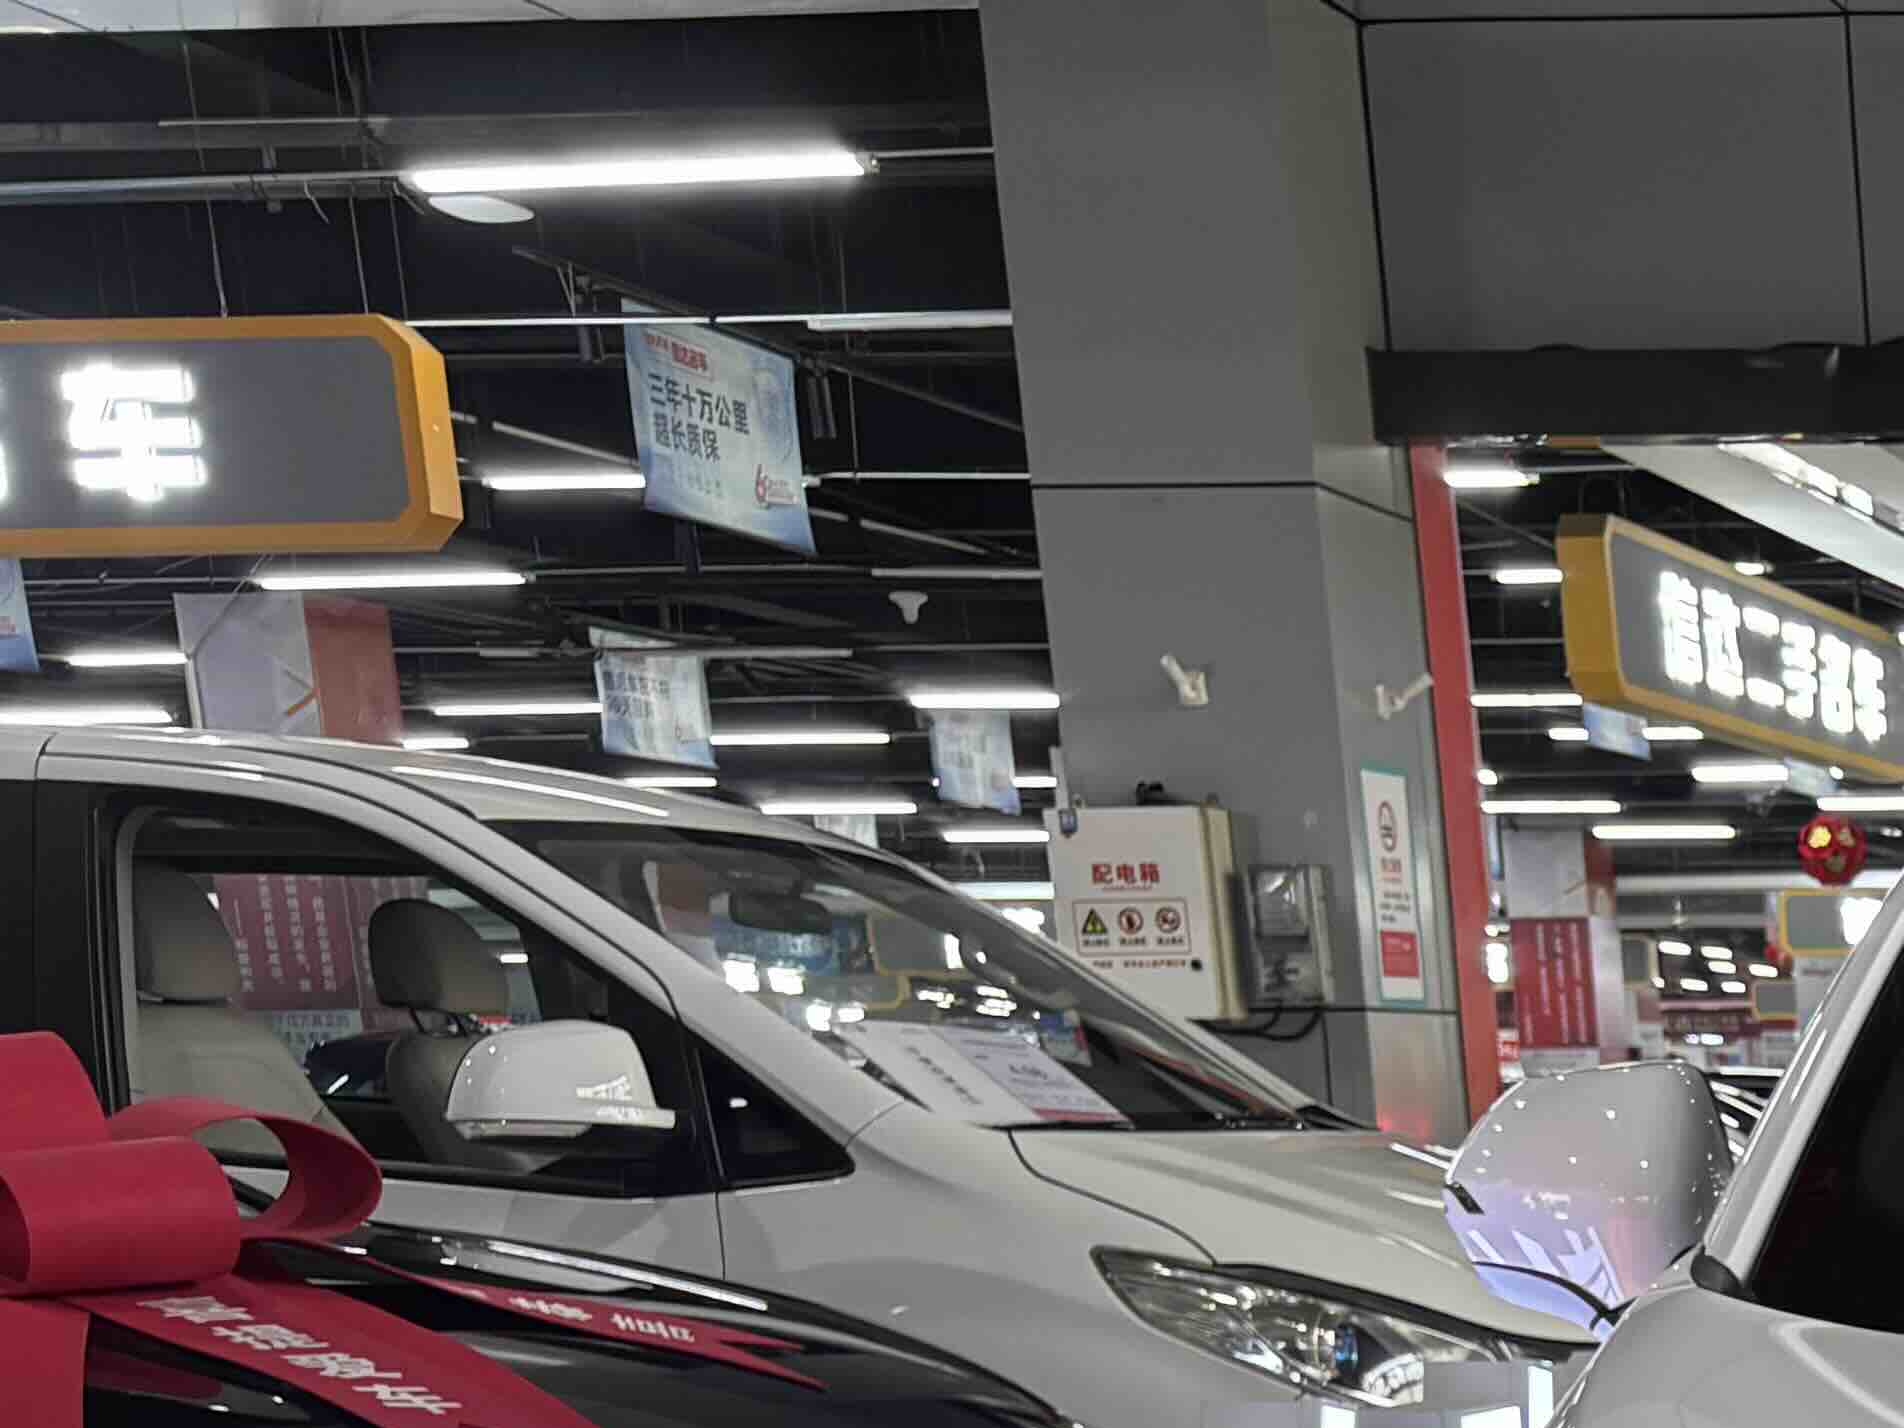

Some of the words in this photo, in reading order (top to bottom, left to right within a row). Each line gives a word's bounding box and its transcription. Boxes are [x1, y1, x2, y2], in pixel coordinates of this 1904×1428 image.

[649, 373, 749, 435] 三年十万公里
[1091, 863, 1160, 884] 配电箱
